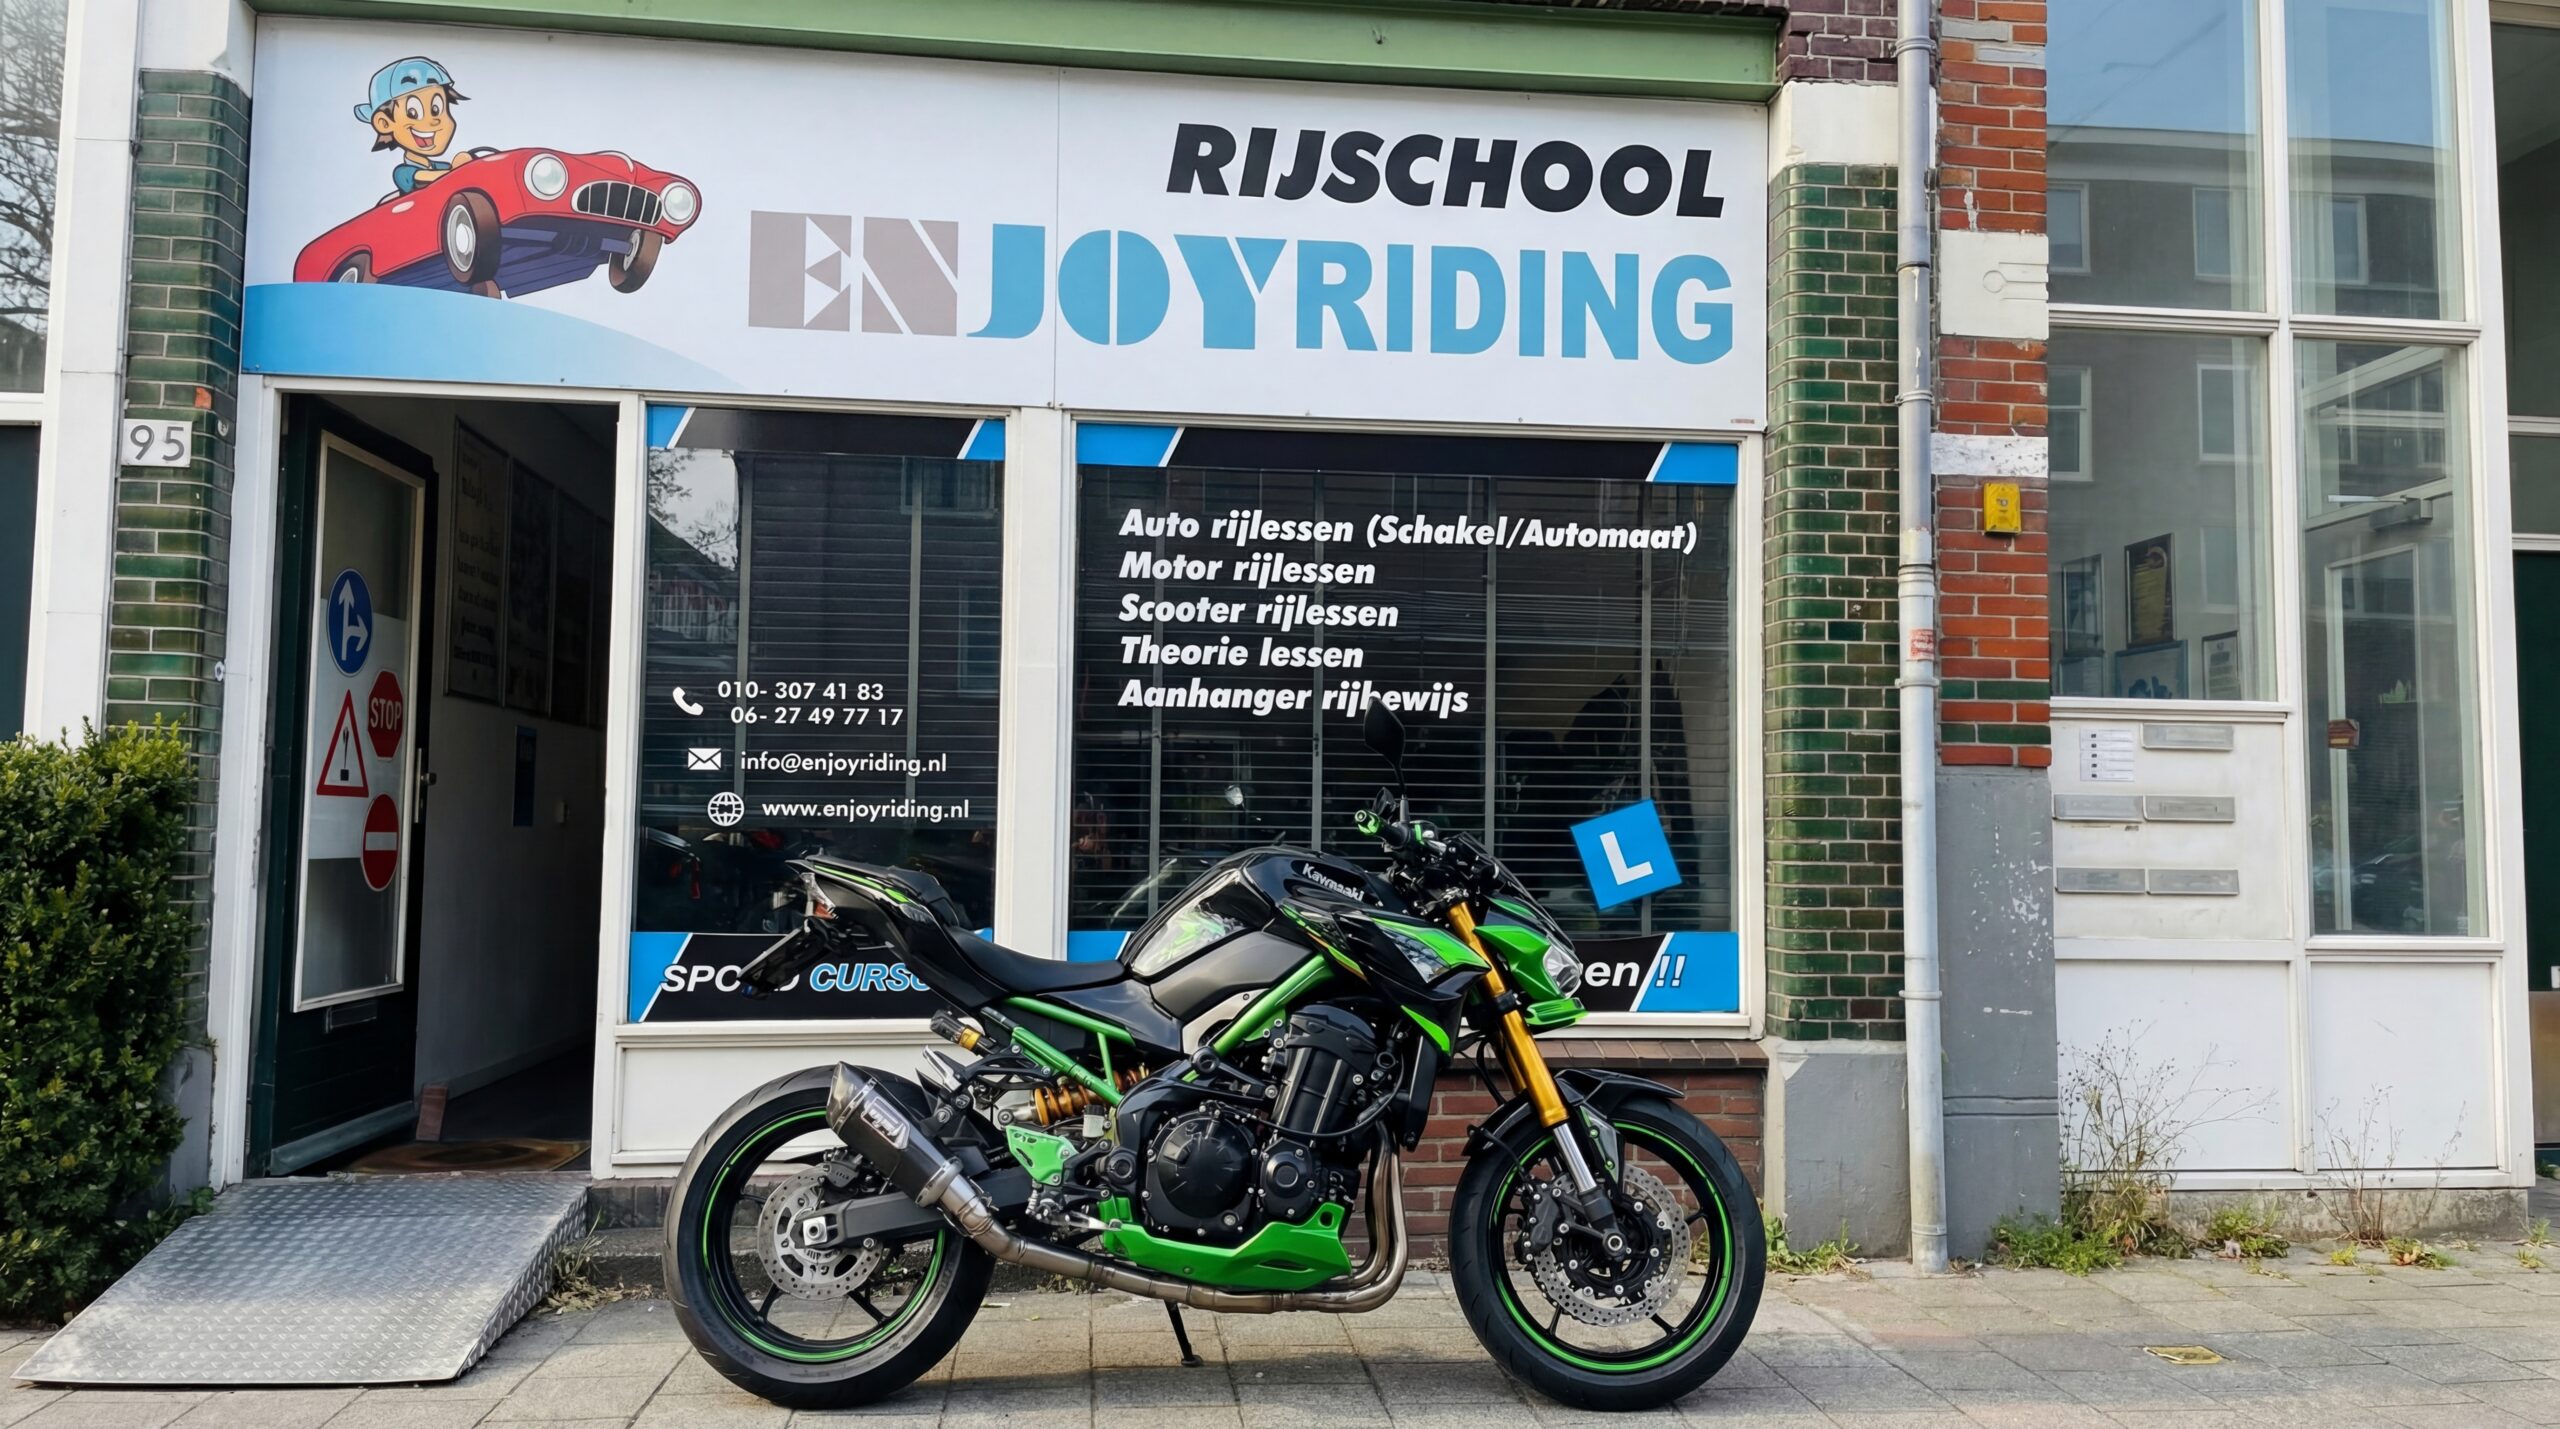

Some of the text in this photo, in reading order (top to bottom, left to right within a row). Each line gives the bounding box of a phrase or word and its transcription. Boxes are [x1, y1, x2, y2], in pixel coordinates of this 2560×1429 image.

[1166, 122, 1725, 219] RIJSCHOOL
[748, 209, 1733, 366] ENJOYRIDING
[130, 424, 185, 461] 95
[1119, 509, 1696, 554] Auto rijlessen (Schakel/Automaat)
[1119, 551, 1375, 589] Motor rijlessen
[1119, 594, 1398, 631] Scooter rijlessen
[1121, 635, 1363, 667] Theorie lessen
[718, 681, 883, 700] 010- 307 41 83
[1118, 678, 1312, 716] Aanhanger
[370, 697, 402, 731] STOP
[731, 707, 903, 725] 06- 27 49 77 17
[741, 751, 946, 776] info@enjoyriding.nl
[762, 799, 968, 822] www.enjoyriding.nl
[1599, 830, 1654, 886] L
